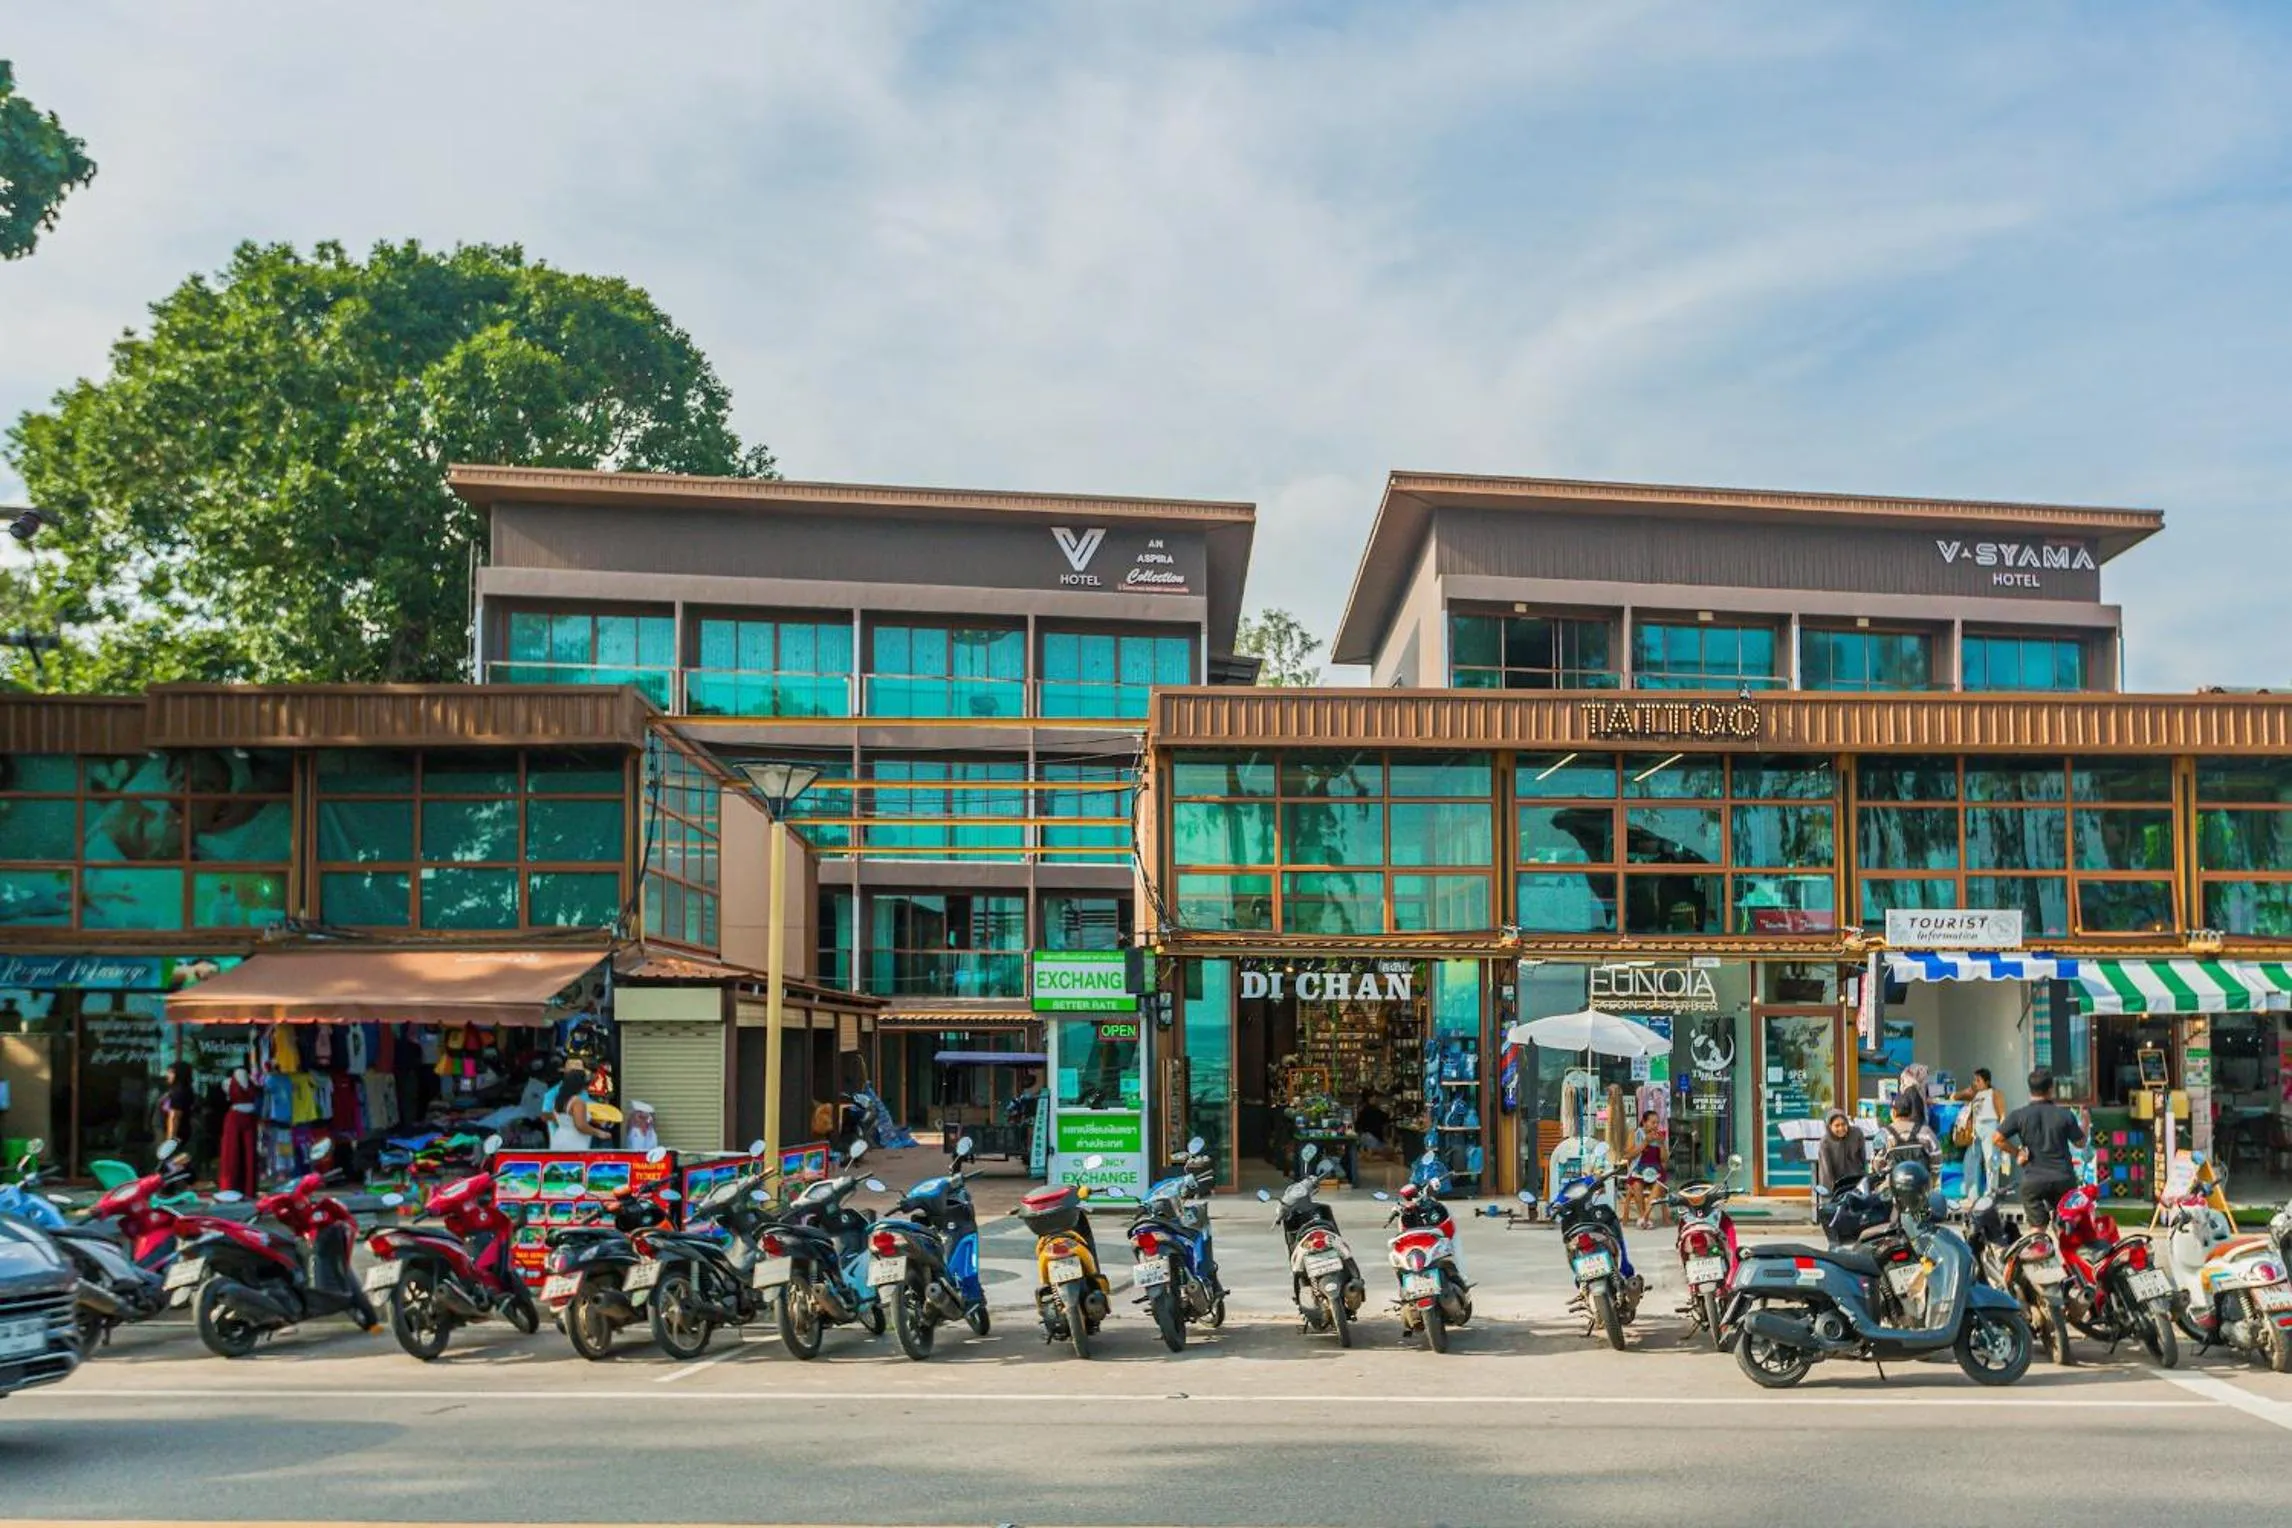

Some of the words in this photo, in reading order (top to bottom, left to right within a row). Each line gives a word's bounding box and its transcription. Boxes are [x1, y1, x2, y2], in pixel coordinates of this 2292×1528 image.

[1148, 539, 1163, 548] AN
[1136, 553, 1174, 564] ASPIRA
[1060, 574, 1101, 586] HOTEL
[1126, 568, 1185, 585] Collection
[1993, 573, 2040, 587] HOTEL
[1581, 703, 1760, 736] TATTOO
[1909, 915, 1988, 929] TOURIST
[1917, 930, 1978, 941] Information
[2, 958, 64, 983] Royal
[1036, 970, 1123, 990] EXCHANG
[1241, 971, 1284, 999] DI
[1295, 972, 1413, 1000] CHAN
[1052, 1000, 1090, 1010] BETTER
[1091, 1000, 1117, 1010] RATE
[1101, 1024, 1137, 1037] OPEN
[1062, 1171, 1137, 1184] EXCHANGE
